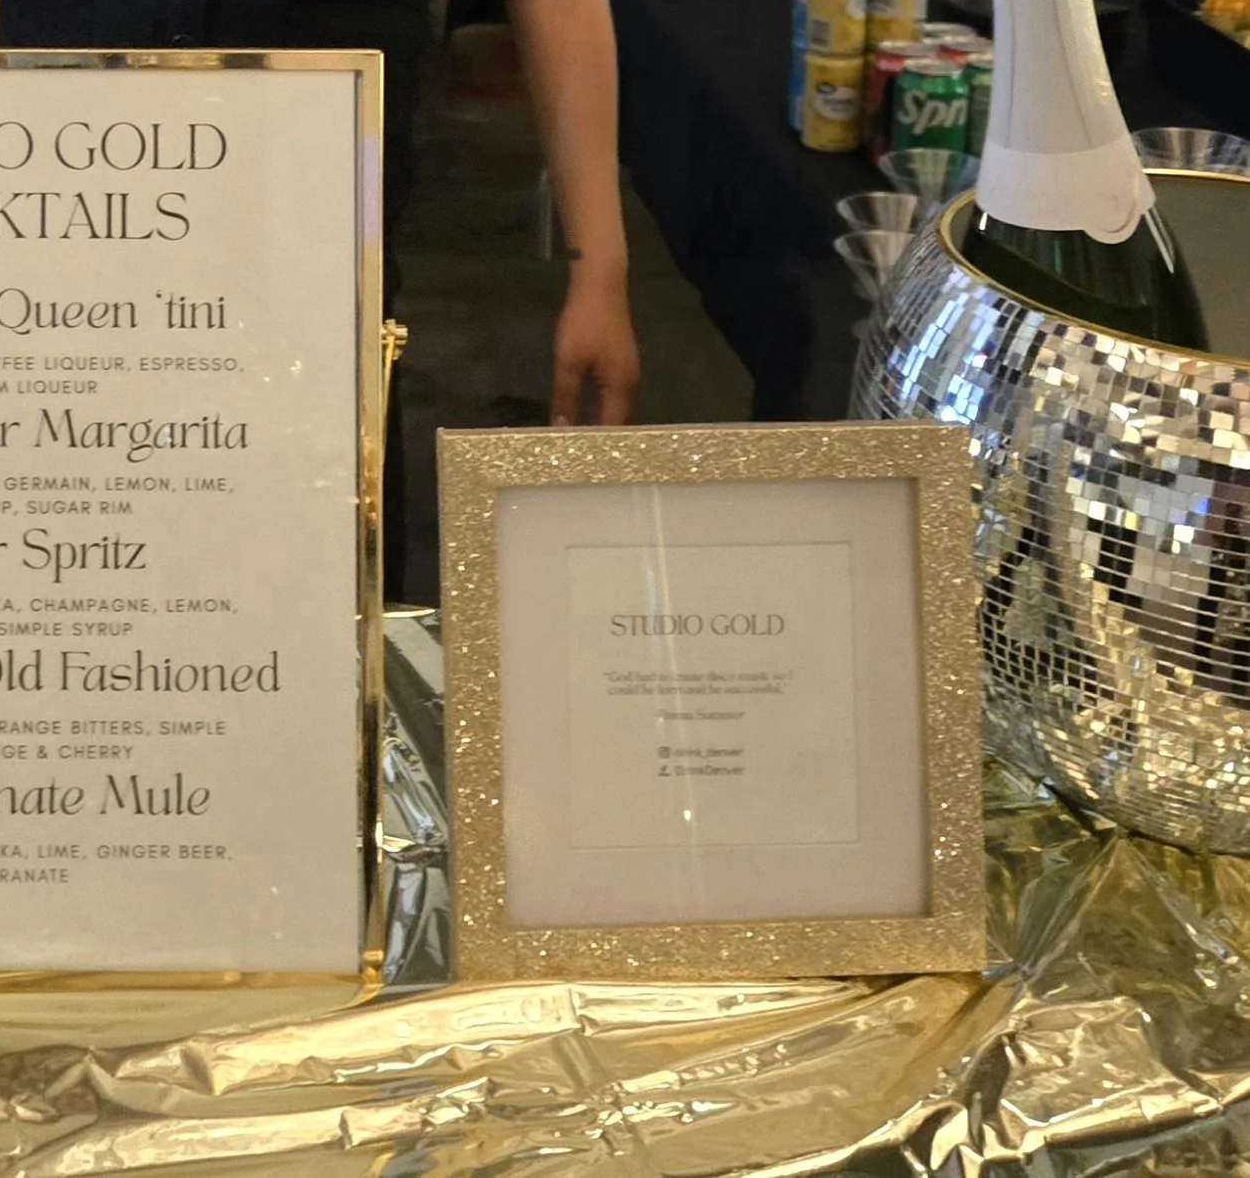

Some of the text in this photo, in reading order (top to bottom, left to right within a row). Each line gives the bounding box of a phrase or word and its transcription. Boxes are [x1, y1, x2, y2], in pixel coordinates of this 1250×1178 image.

[53, 121, 228, 172] GOLD
[43, 355, 133, 373] LIQUEUR,
[138, 356, 245, 374] ESPRESSO,
[16, 379, 99, 395] LIQUEUR
[32, 407, 249, 464] Margarita
[2, 475, 98, 494] GERMAIN,
[103, 475, 177, 494] LEMON,
[184, 476, 236, 495] LIME,
[25, 499, 93, 516] SUGAR
[98, 499, 134, 515] RIM
[21, 527, 148, 585] Spritz
[28, 597, 158, 615] CHAMPAGNE,
[164, 597, 239, 615] LEMON,
[70, 621, 134, 638] SYRUP
[609, 612, 786, 638] STUDIO GOLD
[59, 648, 282, 694] Fashioned
[69, 719, 152, 737] BITTERS,
[157, 719, 227, 737] SIMPLE
[35, 744, 49, 760] &
[56, 743, 135, 760] CHERRY
[98, 771, 211, 817] Mule
[36, 843, 88, 861] LIME,
[95, 843, 171, 860] GINGER
[178, 843, 233, 862] BEER,
